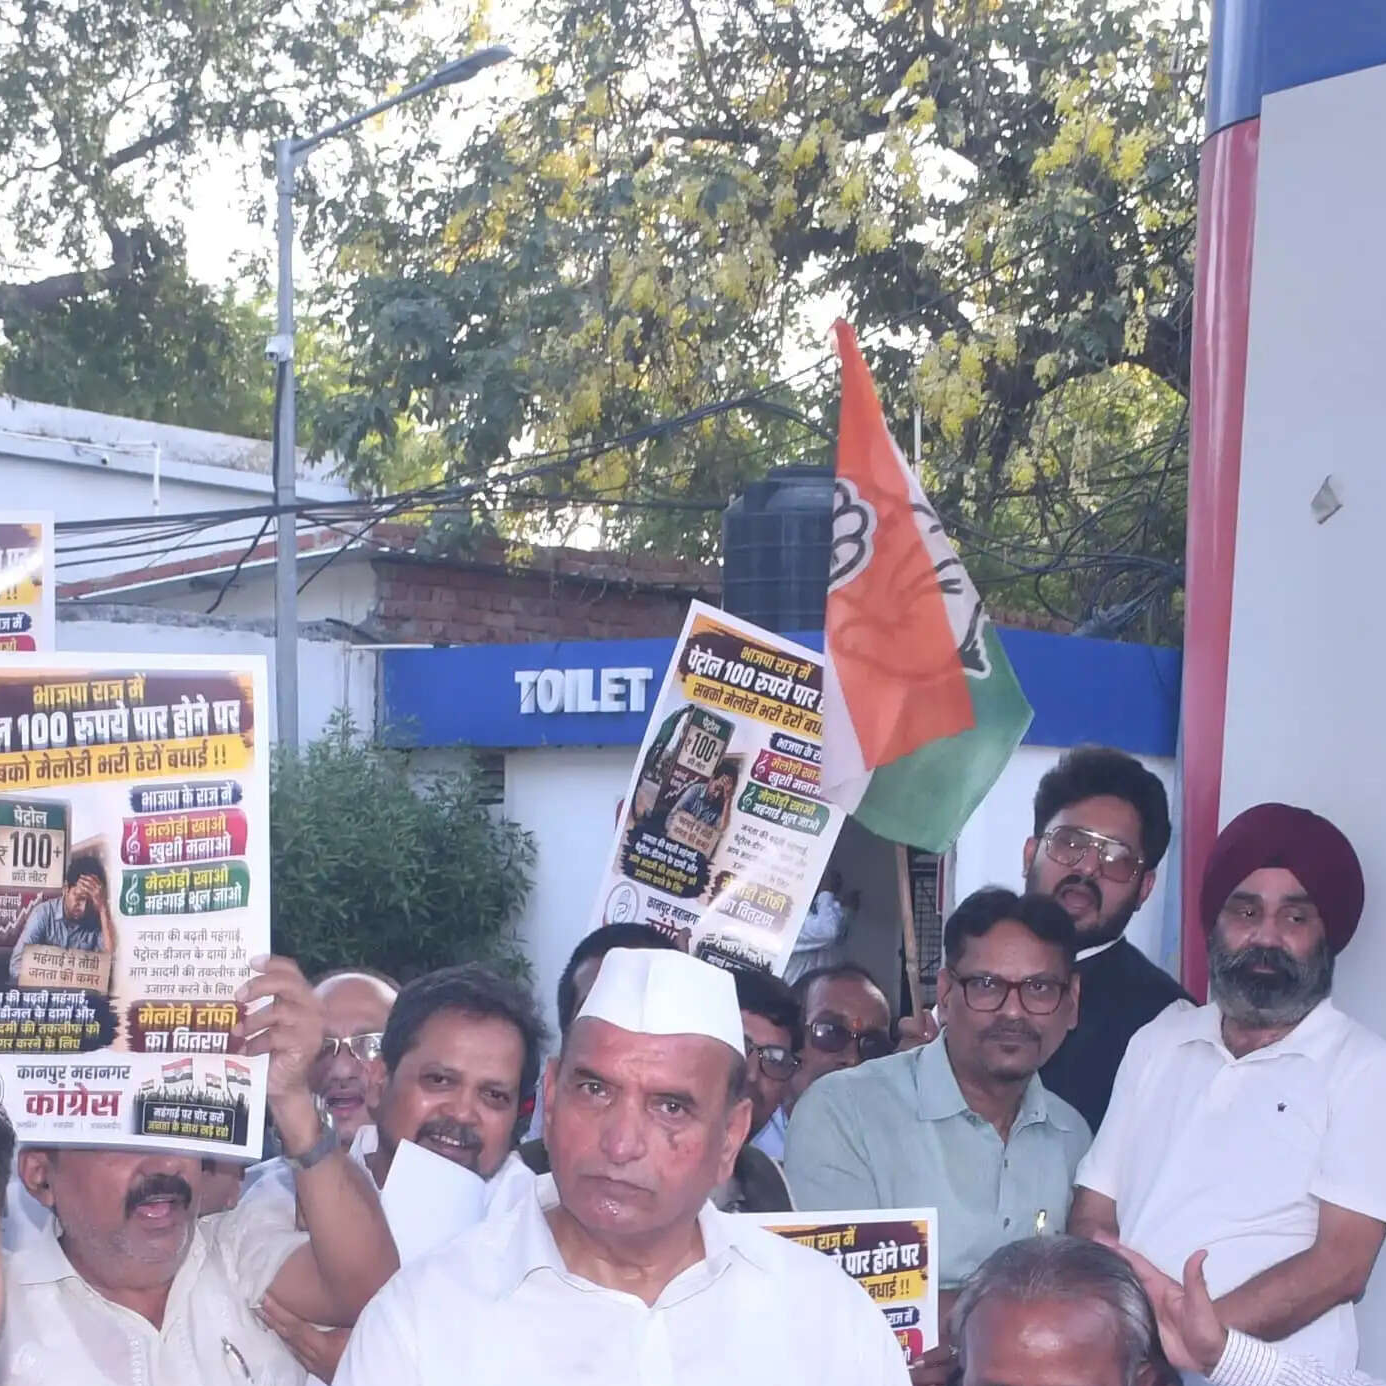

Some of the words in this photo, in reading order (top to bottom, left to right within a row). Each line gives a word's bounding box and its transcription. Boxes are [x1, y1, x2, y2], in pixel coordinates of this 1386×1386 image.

[687, 644, 725, 676] पेट्रोल
[723, 661, 755, 688] 100
[754, 671, 795, 700] रुपये
[793, 683, 819, 708] पार
[740, 646, 776, 669] भाजपा
[775, 657, 798, 677] राज
[798, 663, 816, 681] में
[33, 683, 88, 706] भाजपा
[90, 680, 124, 702] राज
[127, 673, 146, 699] में
[514, 667, 653, 714] TOILET
[17, 712, 68, 748] 100
[73, 701, 130, 742] रुपये
[132, 705, 169, 737] पार
[170, 694, 210, 737] होने
[211, 700, 241, 732] पर
[36, 750, 92, 780] मेलोडी
[97, 748, 130, 775] भरी
[135, 744, 163, 772] ढेरों
[167, 740, 208, 768] बधाई
[818, 1231, 840, 1250] राज
[842, 1225, 857, 1247] में
[845, 1251, 871, 1275] पार
[873, 1240, 899, 1274] होने
[900, 1243, 920, 1267] पर
[868, 1276, 897, 1299] बधाई
